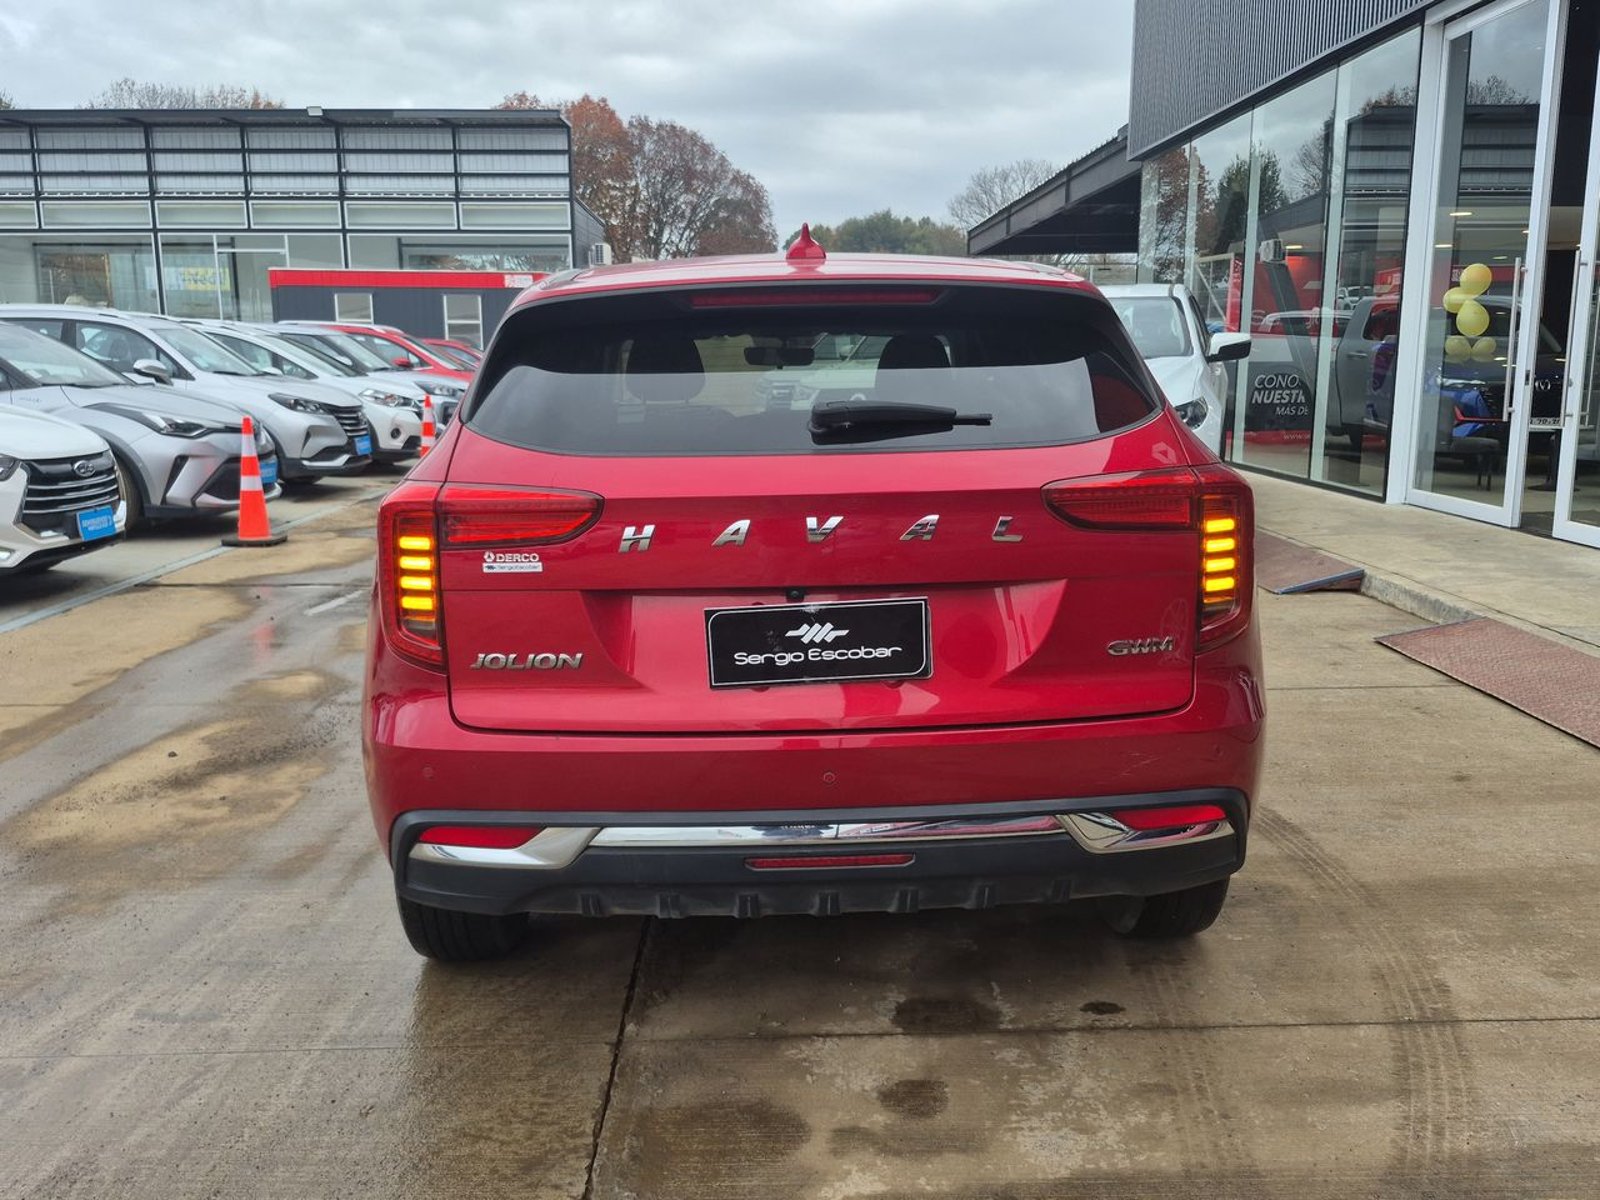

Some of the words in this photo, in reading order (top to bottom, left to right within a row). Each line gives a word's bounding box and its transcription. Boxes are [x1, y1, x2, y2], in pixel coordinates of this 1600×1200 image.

[618, 514, 1024, 553] HAVAL
[495, 553, 540, 562] DERCO
[733, 651, 805, 667] Sergio
[807, 645, 903, 662] Escobar
[1107, 636, 1173, 656] GWM
[469, 653, 584, 670] JOLION
